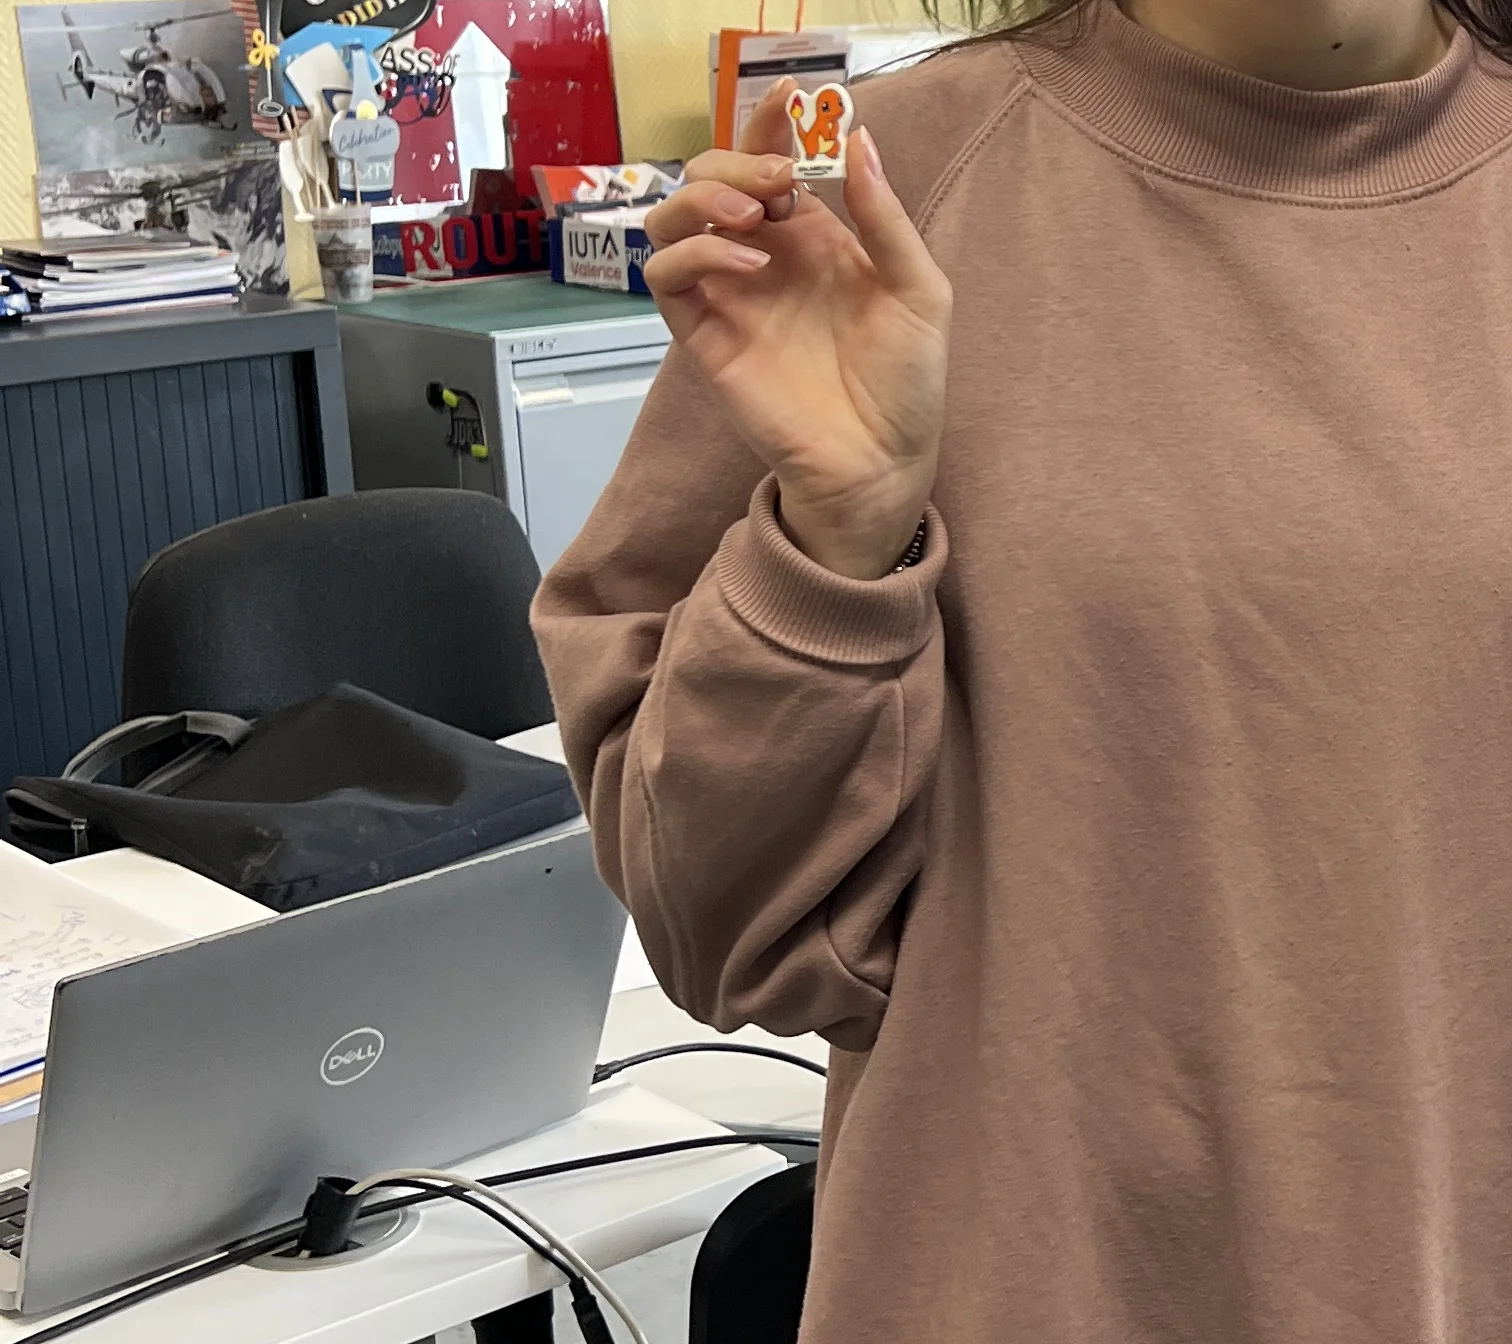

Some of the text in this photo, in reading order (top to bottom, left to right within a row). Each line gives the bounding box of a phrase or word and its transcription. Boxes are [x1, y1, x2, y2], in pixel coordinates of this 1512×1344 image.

[379, 45, 436, 74] ASS
[338, 121, 395, 153] Celebration
[570, 260, 623, 281] Valence
[328, 1044, 377, 1070] DELL
